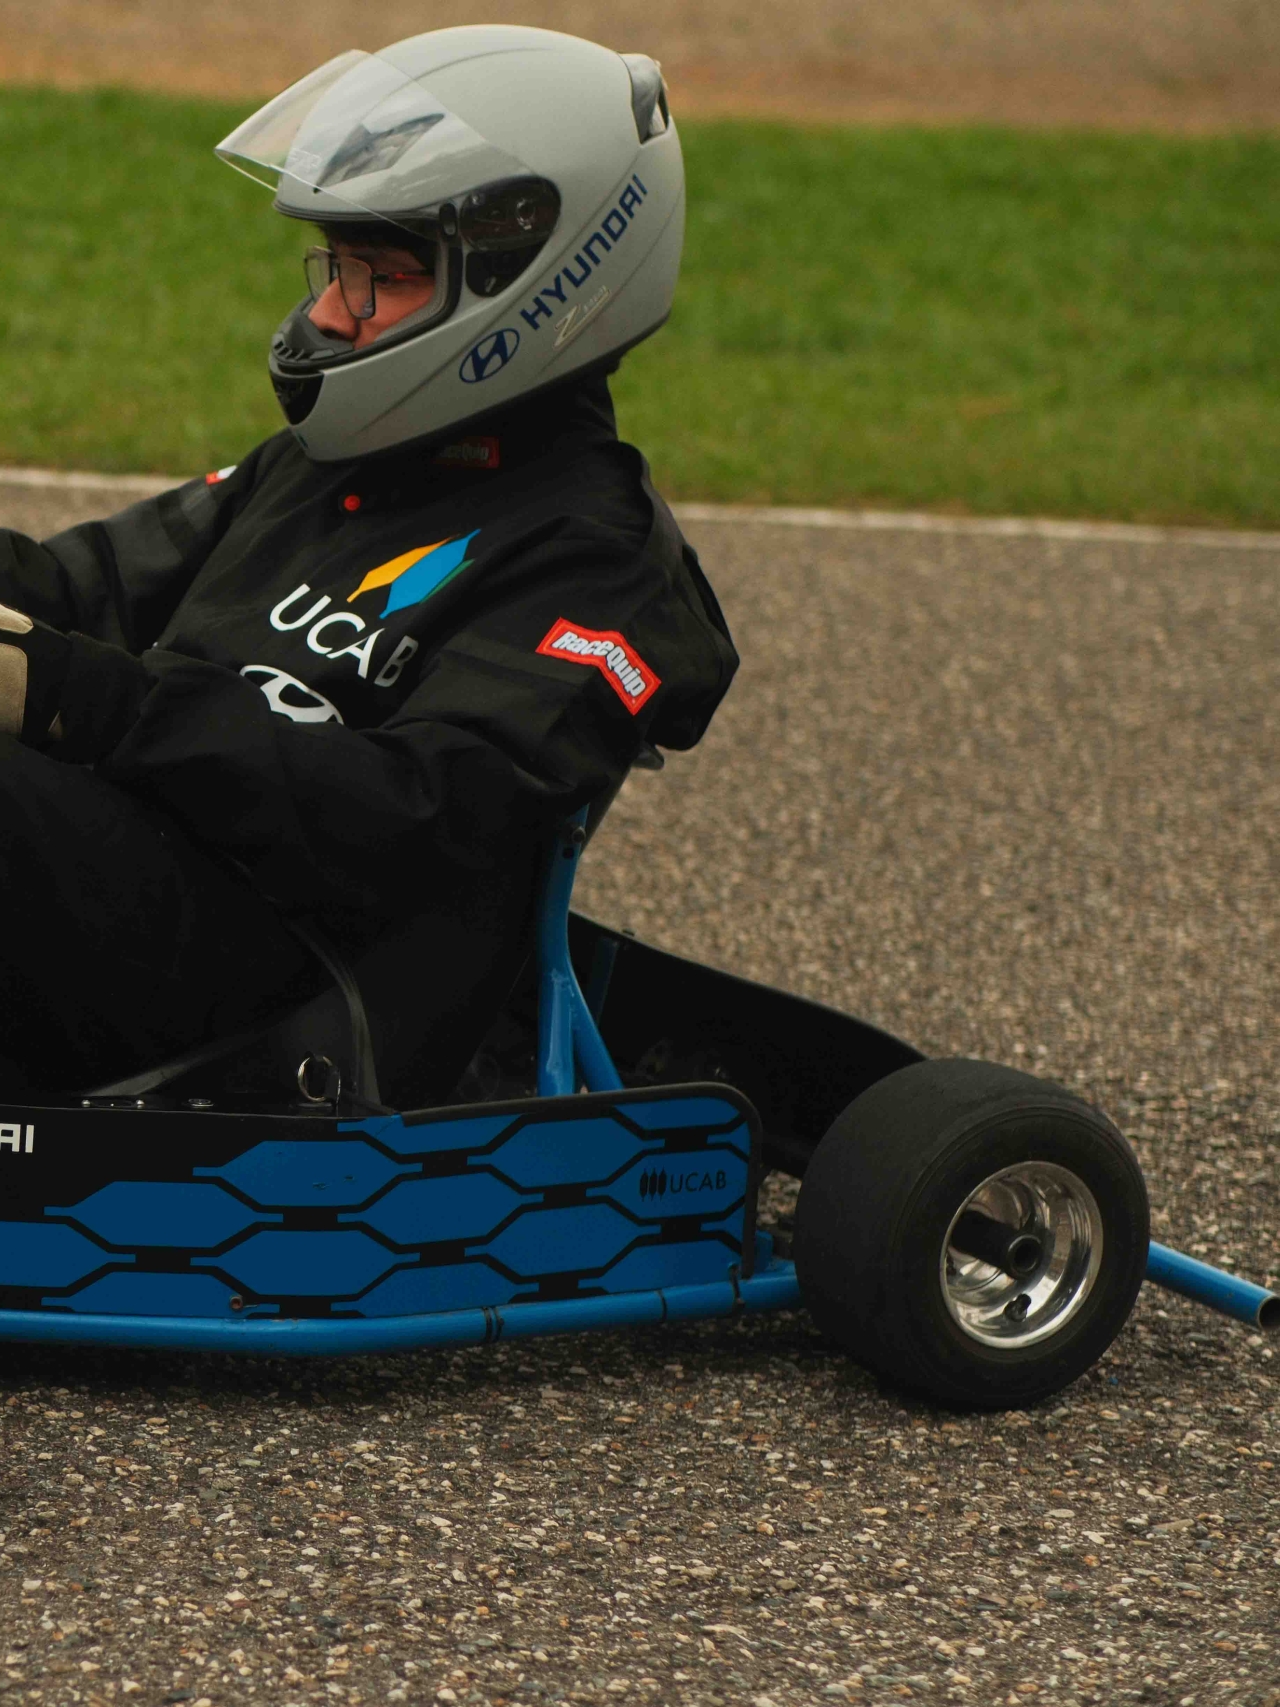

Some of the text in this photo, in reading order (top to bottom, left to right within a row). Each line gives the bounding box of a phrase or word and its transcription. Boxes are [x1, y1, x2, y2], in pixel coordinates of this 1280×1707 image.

[520, 174, 649, 330] HYUNDAI
[269, 583, 419, 687] UCAB
[551, 631, 646, 697] RaceQuip
[670, 1170, 727, 1194] UCAB
